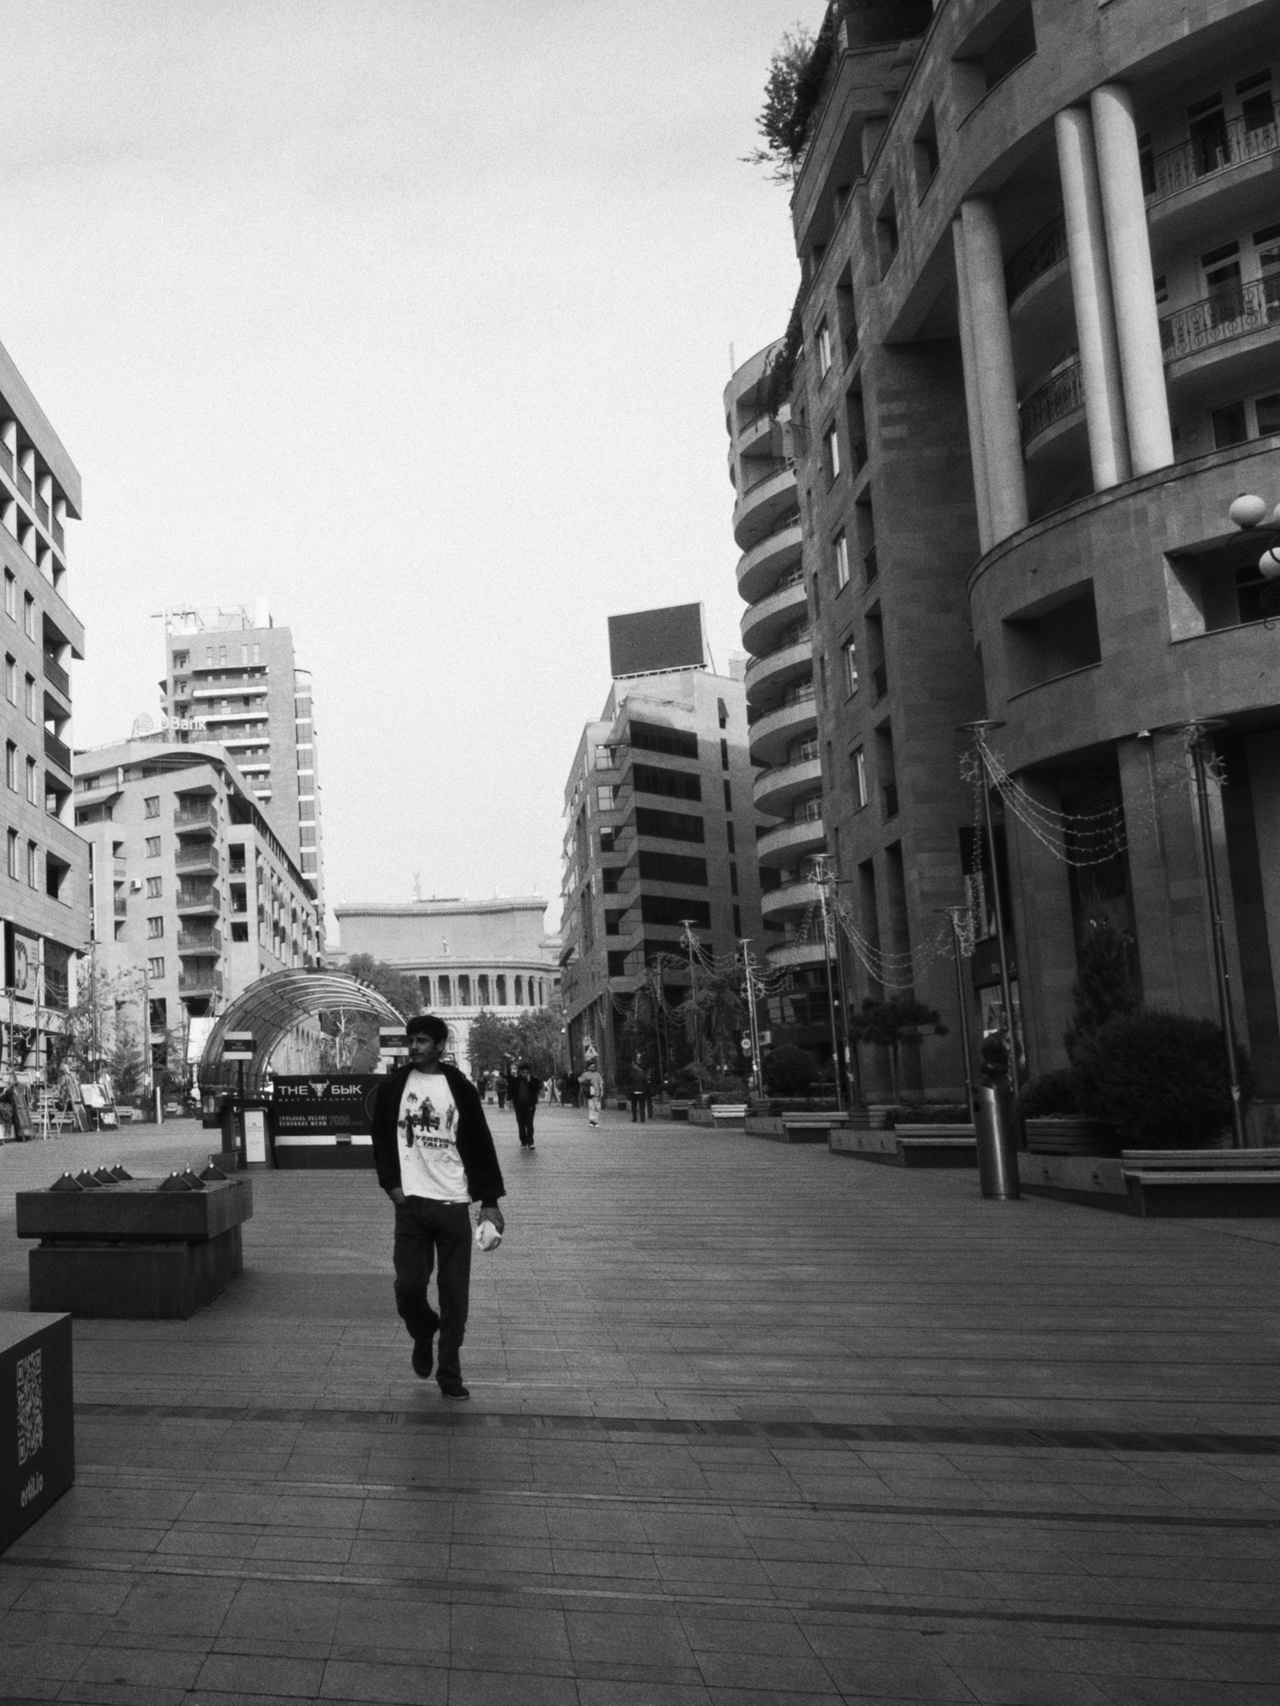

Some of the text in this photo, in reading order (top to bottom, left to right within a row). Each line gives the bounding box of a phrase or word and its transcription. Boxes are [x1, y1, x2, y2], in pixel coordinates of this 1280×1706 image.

[278, 1084, 362, 1095] THE БЫК
[422, 1141, 449, 1149] TALES
